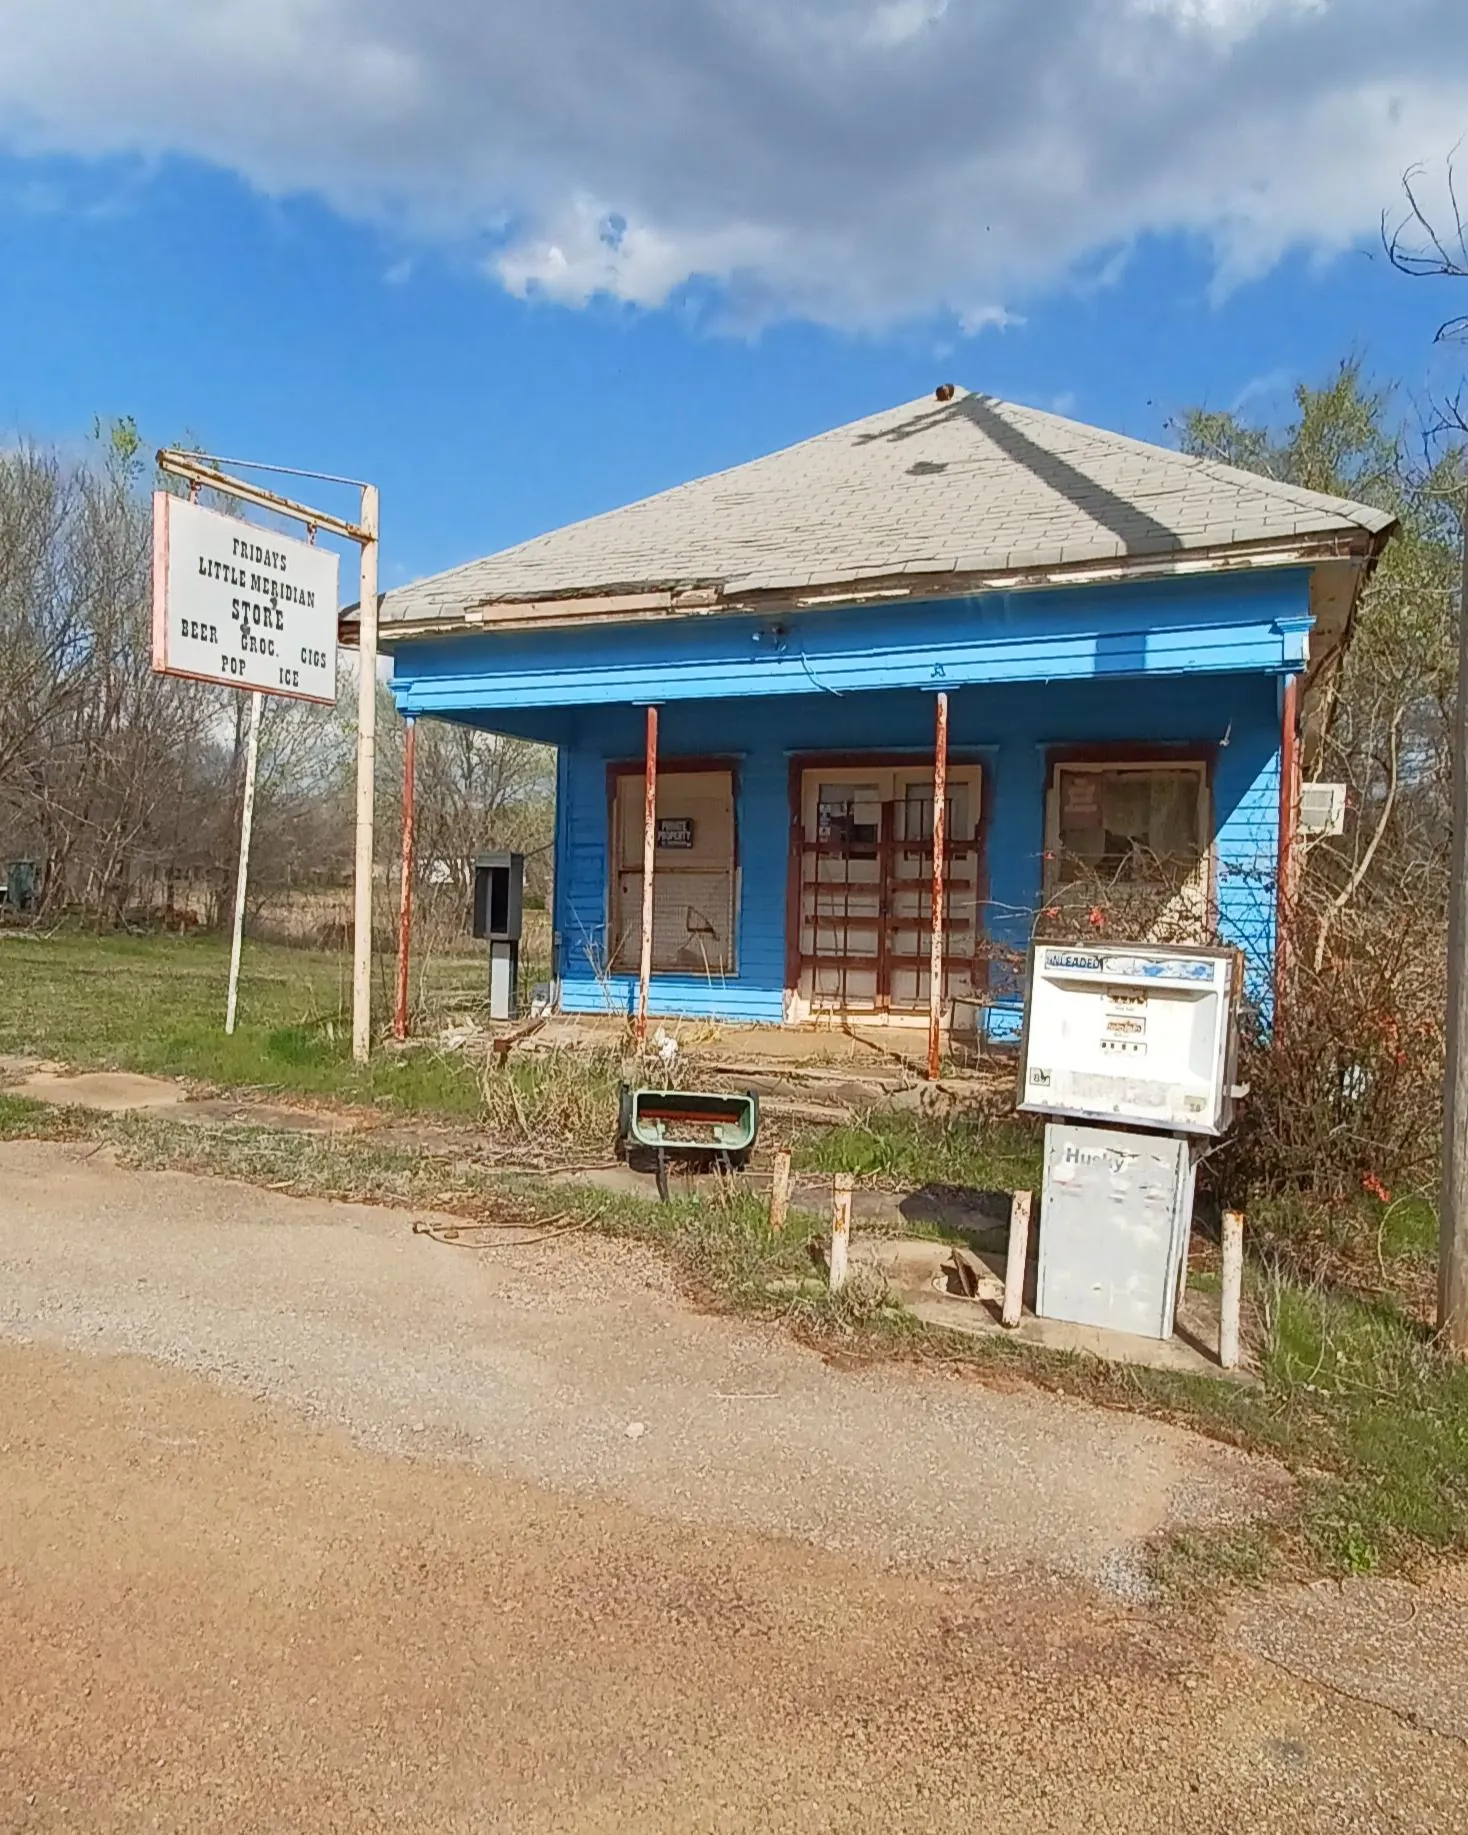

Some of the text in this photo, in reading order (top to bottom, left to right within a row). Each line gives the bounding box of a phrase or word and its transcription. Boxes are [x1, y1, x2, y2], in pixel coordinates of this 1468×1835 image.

[233, 538, 287, 571] FRIDAYS
[199, 556, 315, 608] LITTLE MERIDIAN
[232, 598, 284, 631] STORE
[181, 618, 327, 668] BEER GROC. CIGS
[221, 655, 299, 687] POP ICE
